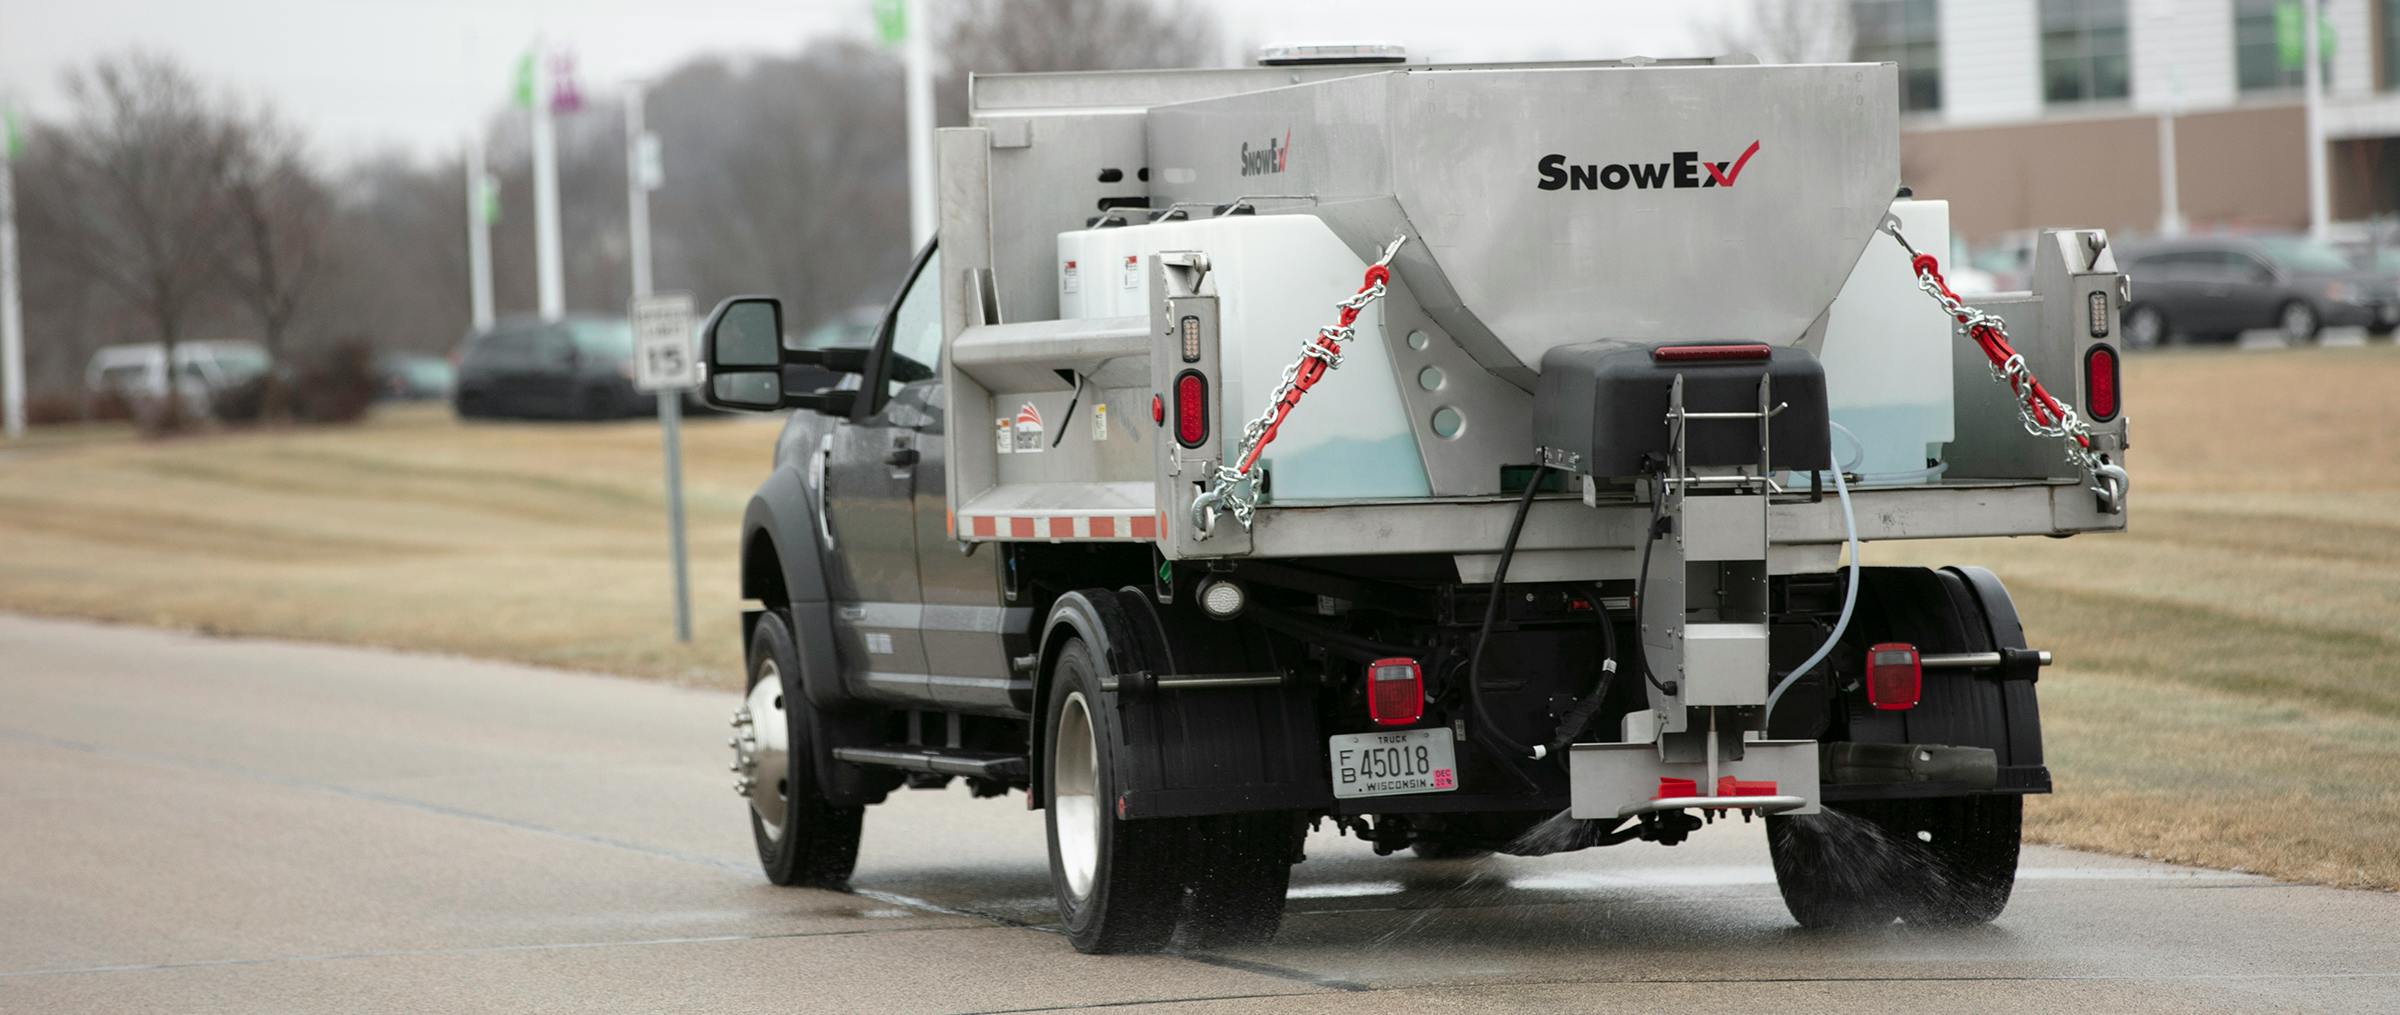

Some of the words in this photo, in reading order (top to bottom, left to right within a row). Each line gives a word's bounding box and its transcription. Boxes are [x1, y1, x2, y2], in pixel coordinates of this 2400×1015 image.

[649, 347, 684, 376] 15
[1378, 736, 1407, 744] TRUCK
[1361, 746, 1429, 779] 45018
[1435, 769, 1451, 778] DEC
[1367, 779, 1427, 791] WISCONSIN
